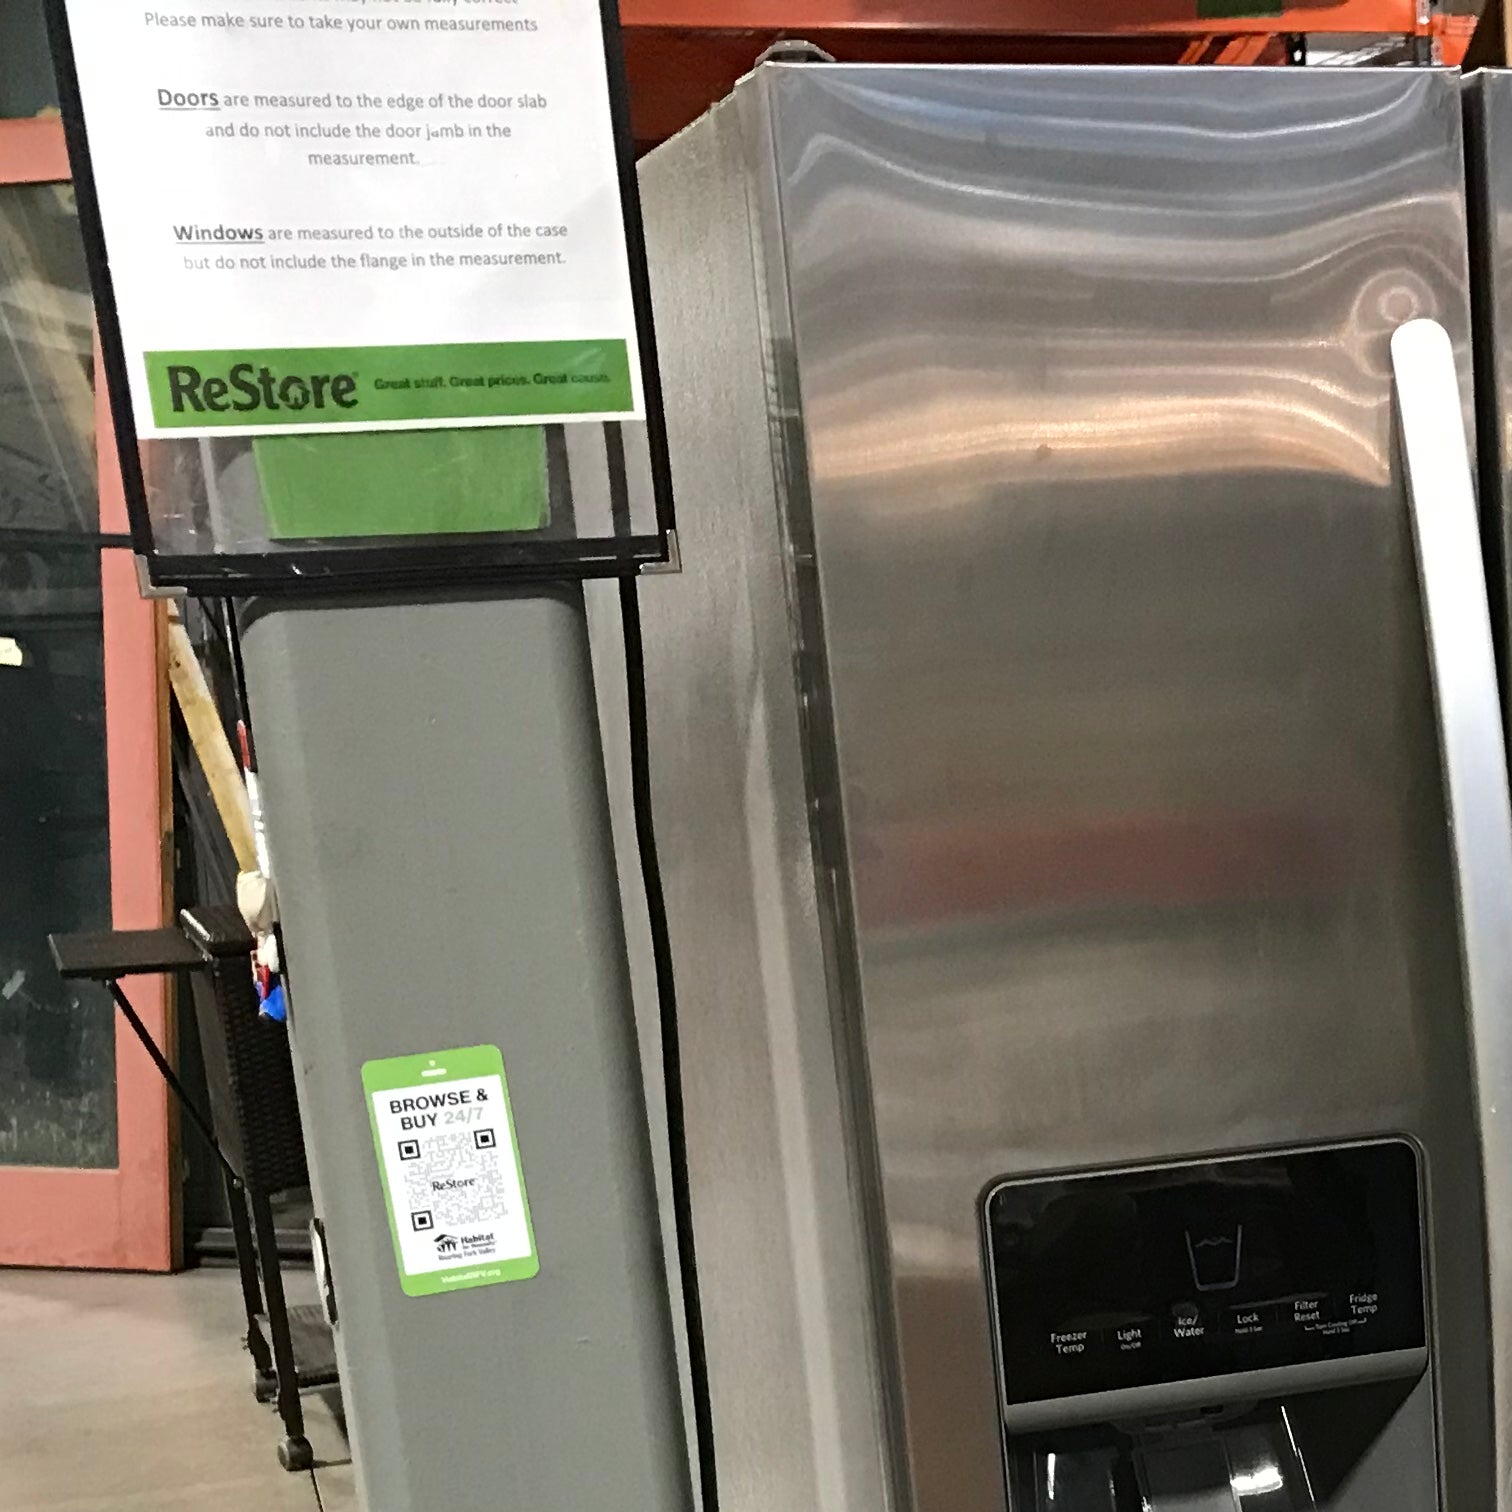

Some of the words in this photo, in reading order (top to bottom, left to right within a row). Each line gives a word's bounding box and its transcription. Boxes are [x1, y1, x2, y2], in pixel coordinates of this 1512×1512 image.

[144, 12, 197, 27] Please
[201, 12, 245, 27] make
[249, 15, 284, 28] sure
[288, 15, 305, 29] to
[309, 14, 343, 29] take
[347, 18, 382, 32] your
[387, 18, 420, 30] own
[424, 18, 538, 32] measurements
[157, 88, 219, 109] Doors
[223, 94, 250, 107] are
[254, 93, 332, 108] measured
[336, 94, 353, 108] to
[356, 93, 382, 108] the
[387, 93, 424, 112] edge
[428, 93, 443, 108] of
[448, 93, 473, 108] the
[477, 93, 513, 108] door
[517, 94, 547, 109] slab
[205, 123, 235, 137] and
[239, 122, 259, 137] do
[264, 124, 291, 137] not
[295, 122, 351, 137] include
[355, 123, 381, 138] the
[385, 123, 421, 138] door
[426, 123, 464, 141] jamb
[468, 124, 482, 137] in
[486, 123, 512, 138] the
[308, 152, 420, 166] measurement.
[173, 224, 264, 243] Windows
[268, 228, 292, 240] are
[297, 225, 373, 240] measured
[377, 226, 394, 239] to
[399, 225, 423, 239] the
[427, 224, 483, 239] outside
[488, 223, 502, 238] of
[507, 223, 531, 238] the
[535, 225, 568, 237] case
[183, 255, 210, 269] but
[215, 255, 235, 269] do
[240, 256, 266, 269] not
[270, 254, 326, 269] include
[331, 254, 356, 268] the
[360, 253, 407, 270] flange
[411, 253, 425, 267] in
[429, 252, 454, 267] the
[459, 252, 566, 266] measurement.
[167, 363, 359, 412] ReStore
[373, 378, 410, 390] Great
[449, 376, 484, 387] Great
[533, 373, 567, 385] Great
[390, 1090, 472, 1114] BROWSE
[476, 1088, 488, 1102] &
[400, 1113, 437, 1131] BUY
[444, 1107, 483, 1125] 24/7
[431, 1178, 475, 1191] ReStore
[1349, 1293, 1378, 1304] Fridge
[1294, 1301, 1318, 1311] Filter
[1350, 1305, 1378, 1315] Temp
[1178, 1314, 1199, 1326] Ice/
[1236, 1312, 1259, 1324] Lock
[1294, 1311, 1320, 1322] Reset
[1051, 1331, 1087, 1343] Freezer
[1117, 1329, 1142, 1341] Light
[1173, 1326, 1205, 1338] Water
[1055, 1343, 1085, 1354] Temp
